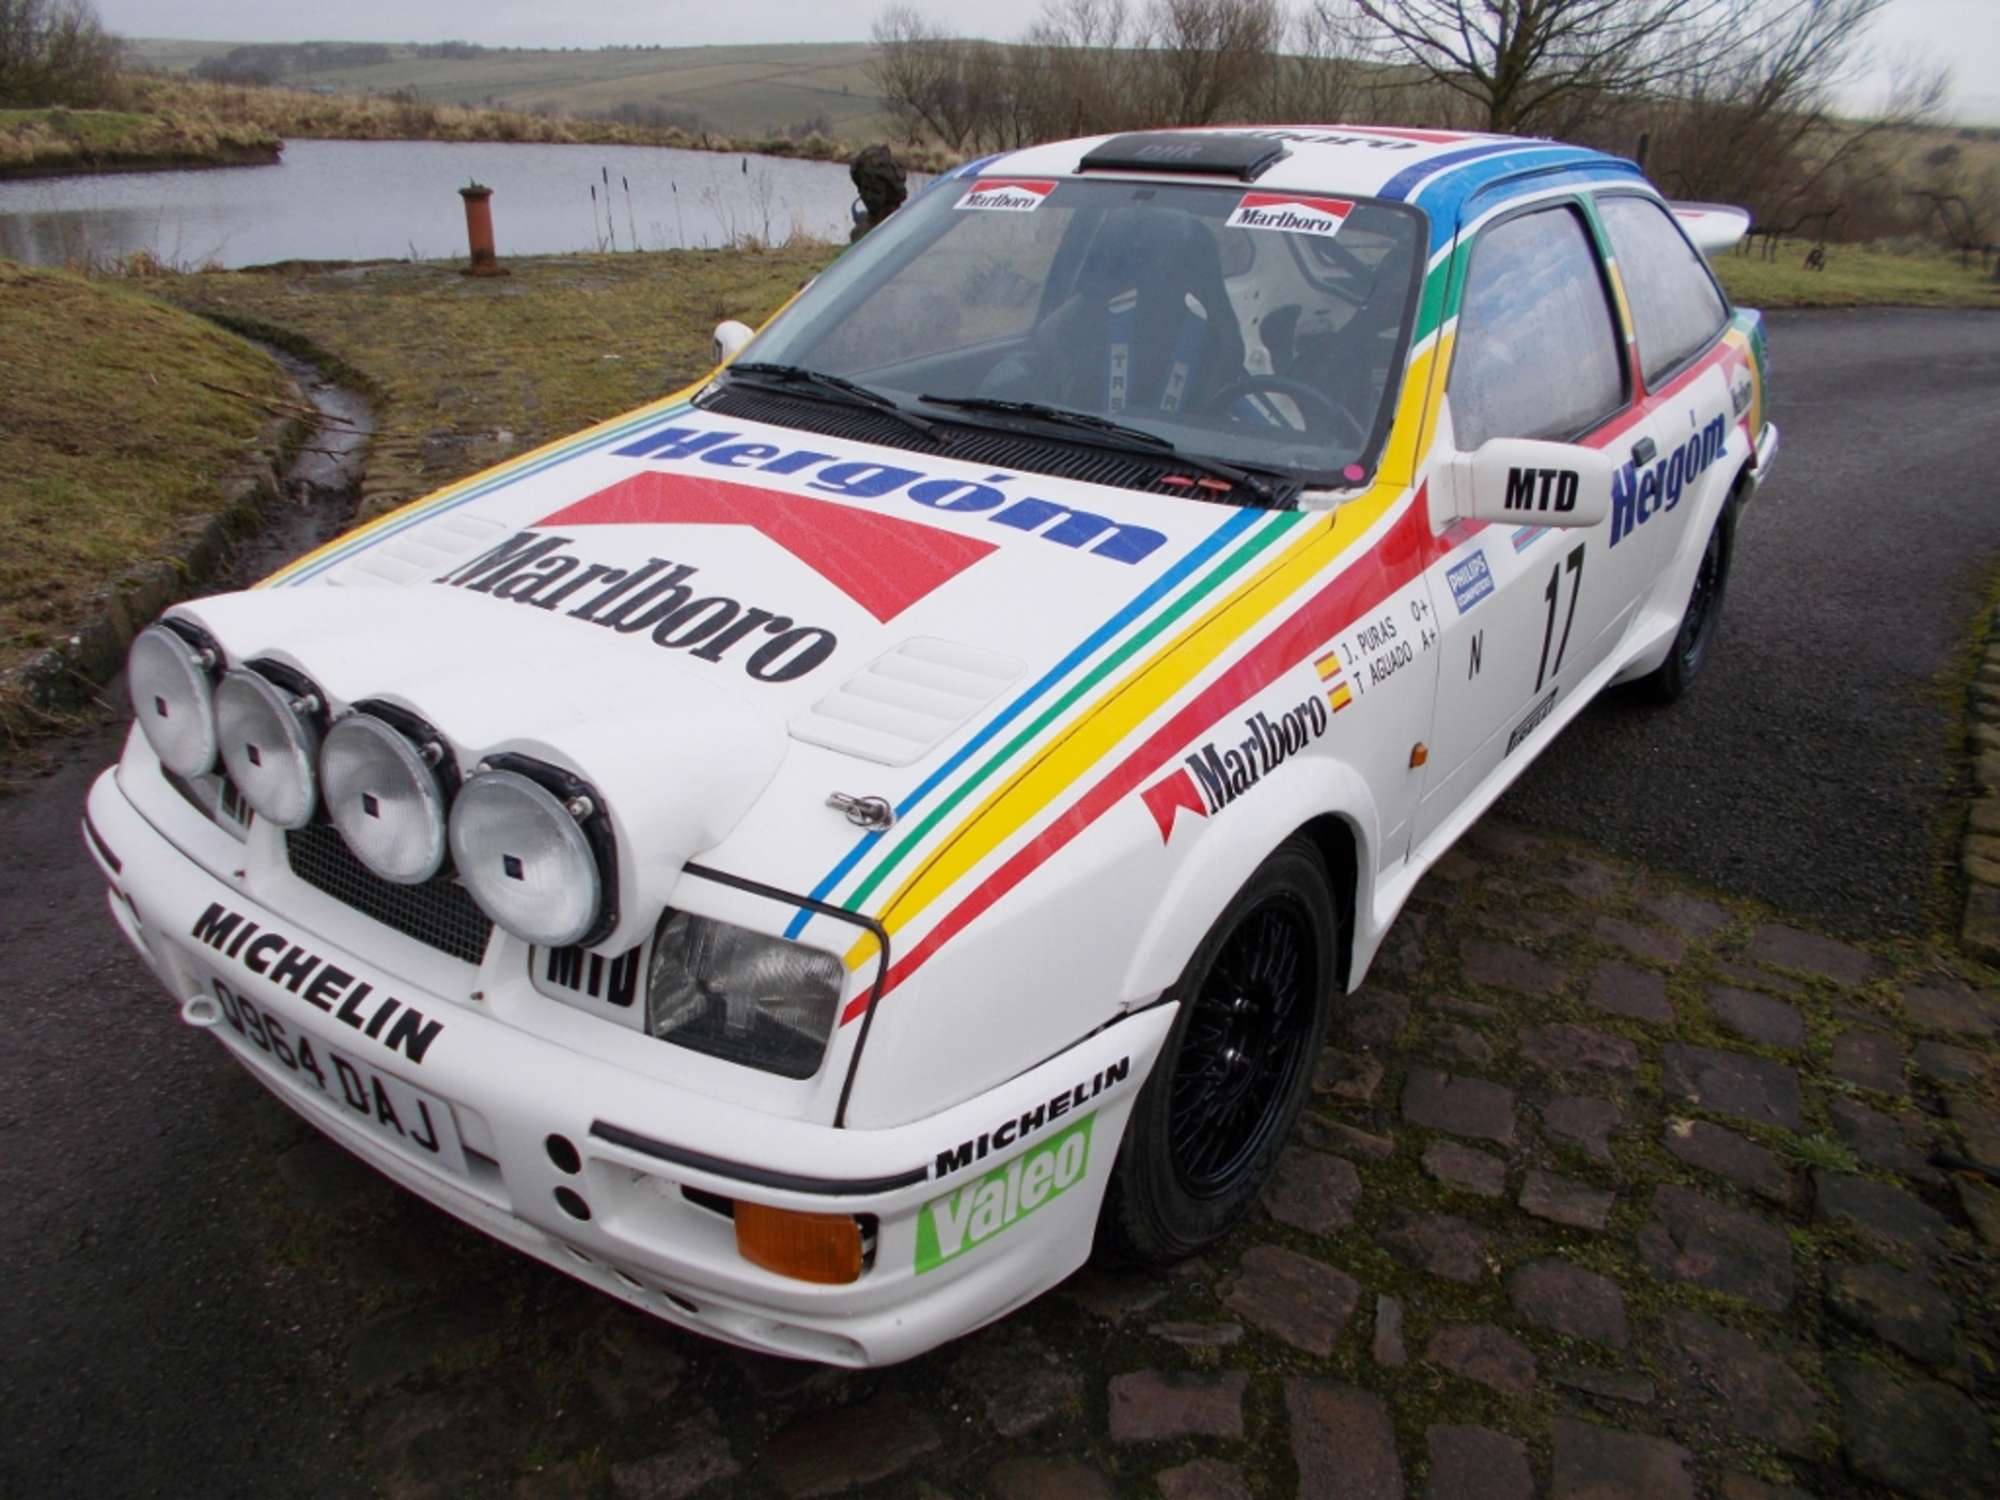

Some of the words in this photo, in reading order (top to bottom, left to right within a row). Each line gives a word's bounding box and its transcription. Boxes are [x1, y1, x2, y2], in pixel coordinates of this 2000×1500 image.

[965, 192, 1036, 208] Marlboro
[1239, 208, 1333, 233] Marlboro
[611, 427, 1169, 566] Hergóm
[1504, 467, 1579, 512] MTD
[1609, 409, 1727, 549] Hergóm
[433, 530, 838, 683] Marlboro
[1357, 616, 1398, 656] PURAS
[1369, 640, 1413, 687] AGUADO
[1467, 629, 1484, 681] N
[1534, 541, 1585, 694] 17
[1186, 695, 1327, 815] Marlboro
[191, 902, 445, 1065] MICHELIN
[329, 1052, 440, 1153] DAJ
[935, 1056, 1131, 1179] MICHELIN
[931, 1129, 1087, 1260] Valeo
